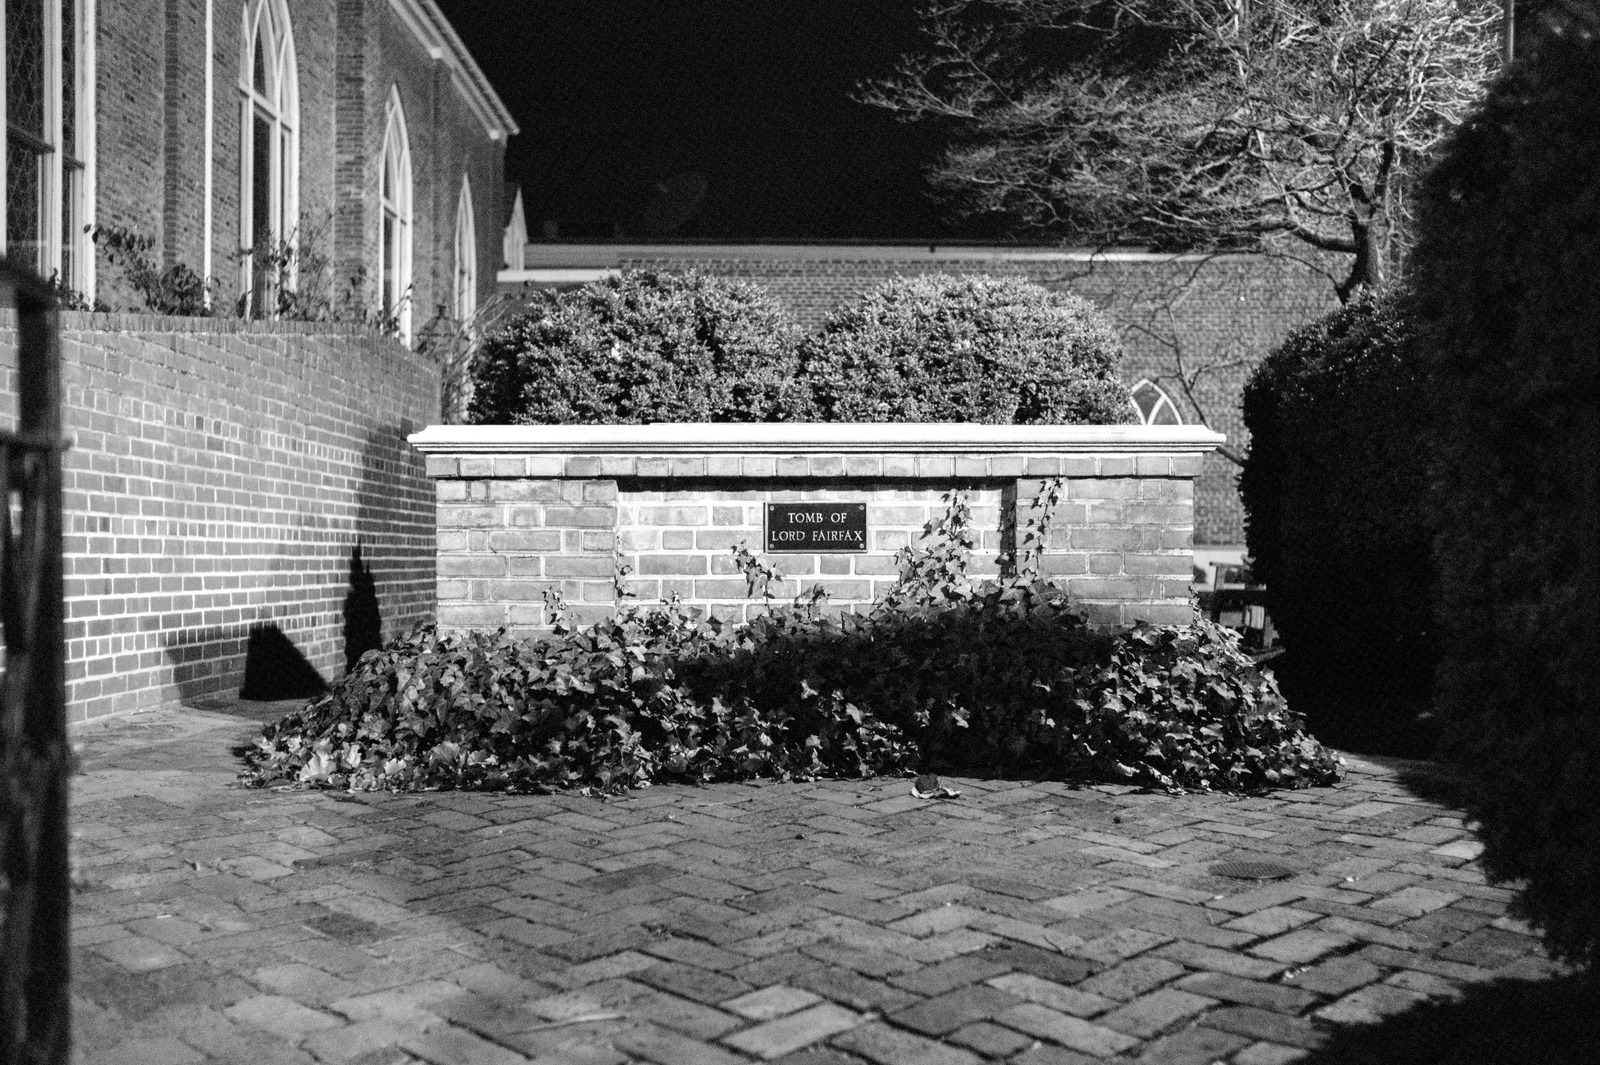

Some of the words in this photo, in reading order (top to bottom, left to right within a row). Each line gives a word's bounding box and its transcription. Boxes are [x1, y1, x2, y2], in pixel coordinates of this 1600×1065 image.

[787, 512, 824, 524] TOMB
[830, 512, 847, 523] OF
[771, 530, 806, 542] LORD
[812, 529, 863, 542] FAIRFAX
